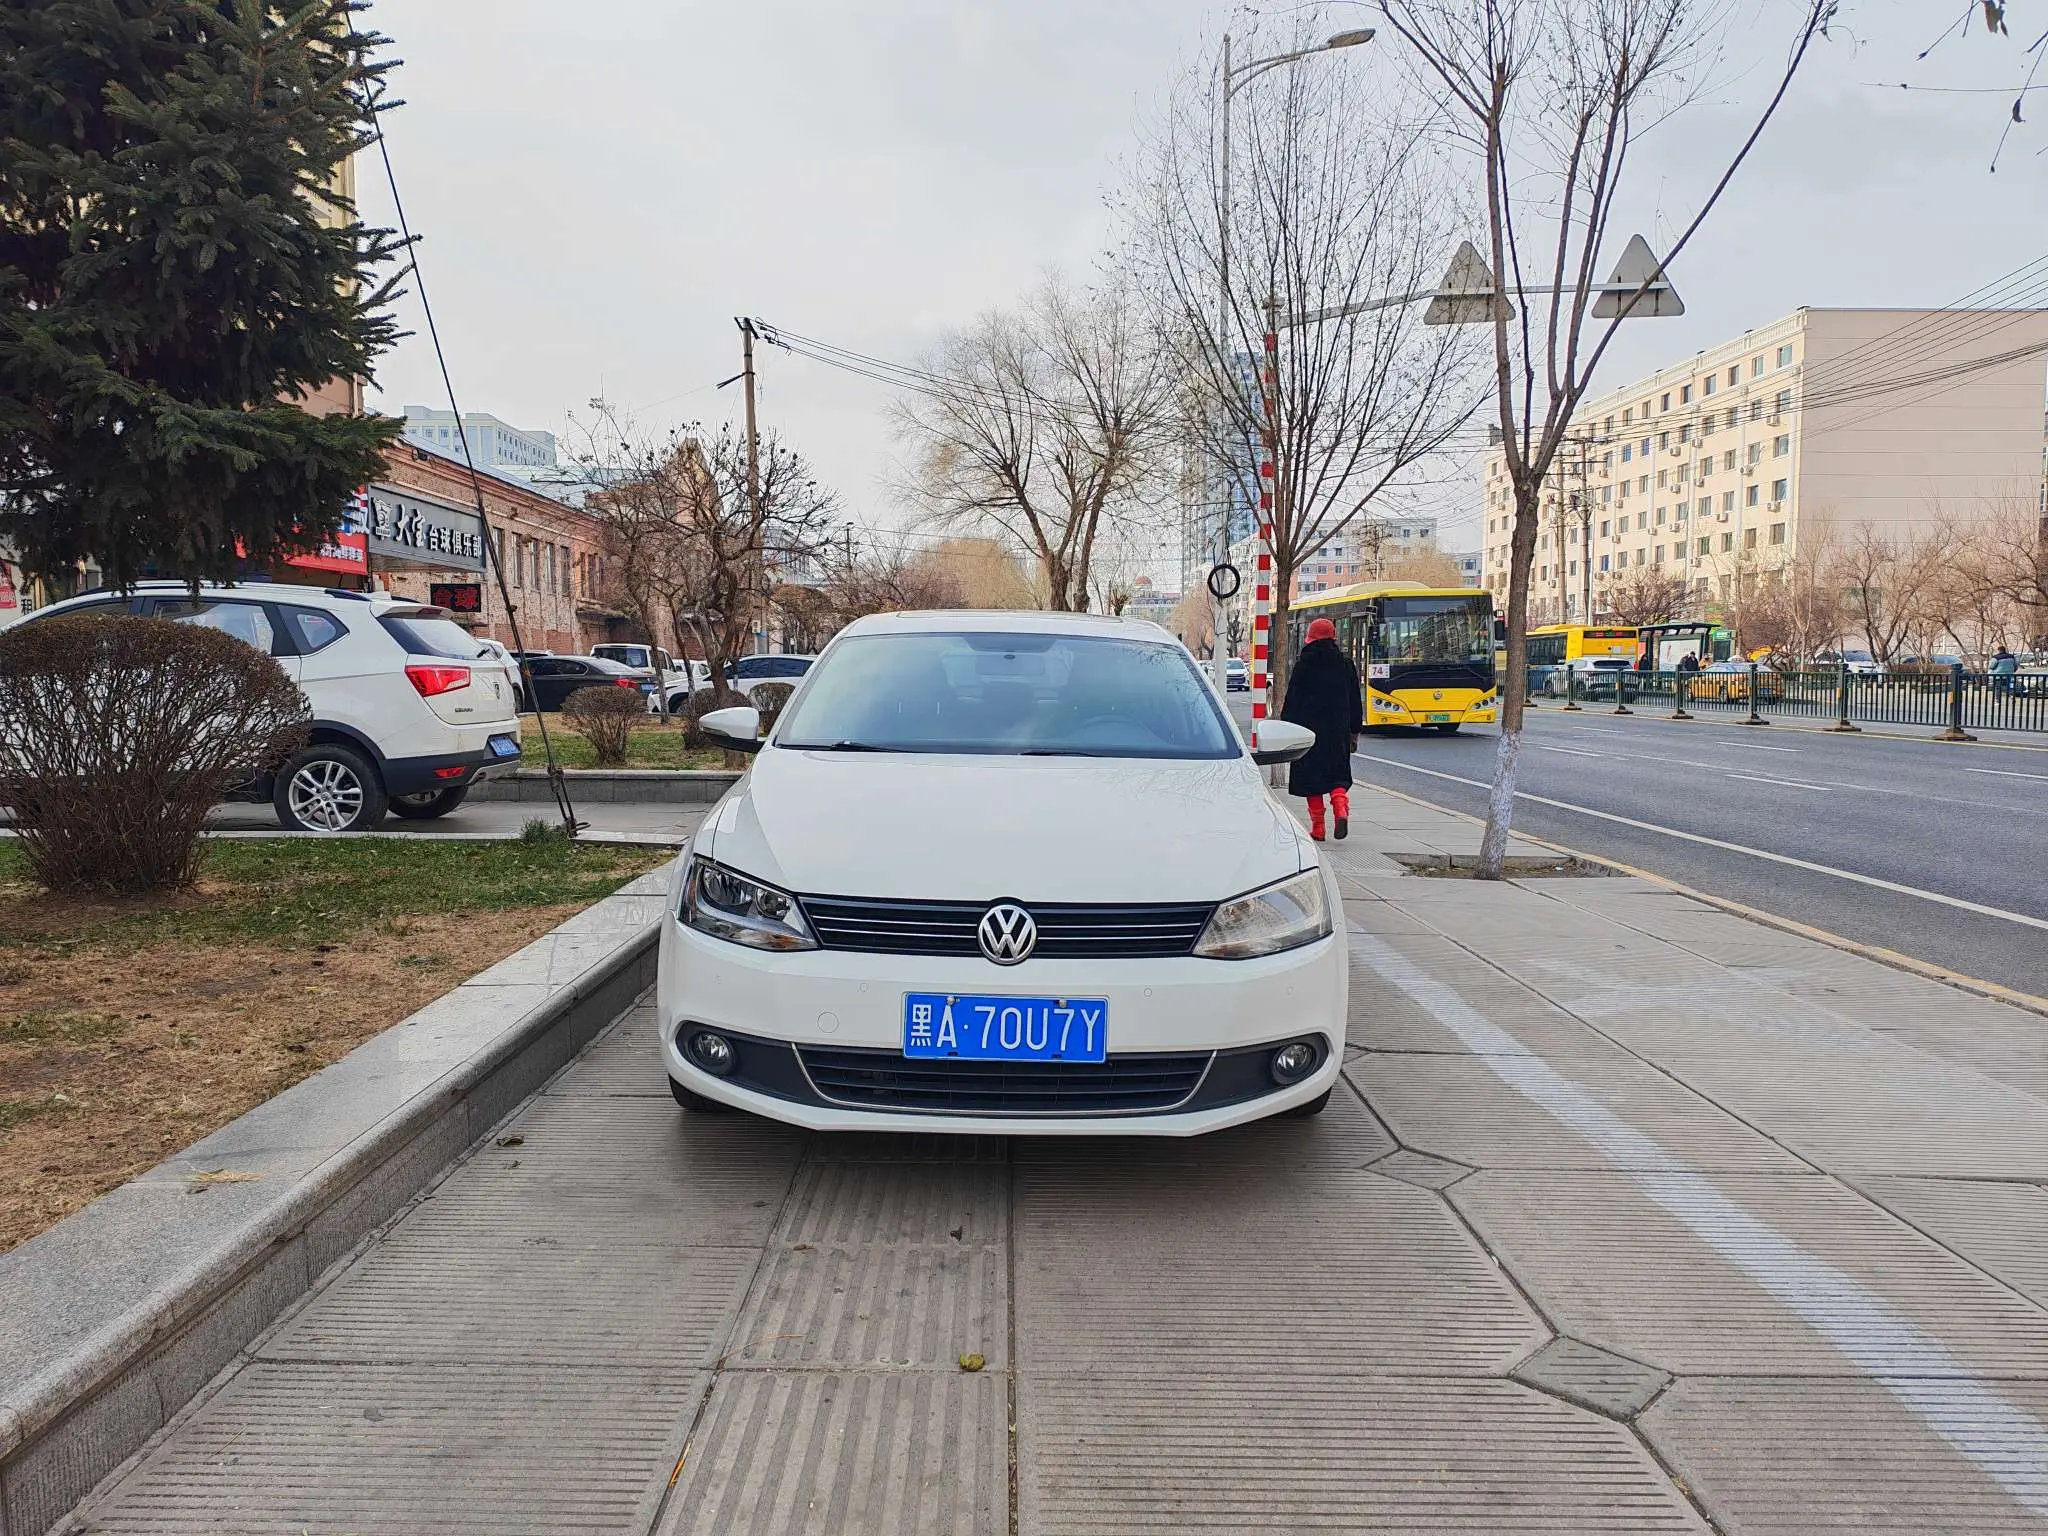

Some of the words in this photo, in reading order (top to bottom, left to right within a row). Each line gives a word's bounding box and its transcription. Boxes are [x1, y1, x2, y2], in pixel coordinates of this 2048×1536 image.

[433, 586, 478, 609] 台球
[1371, 666, 1384, 676] 74
[910, 1003, 1101, 1052] 黑A·70U7Y
